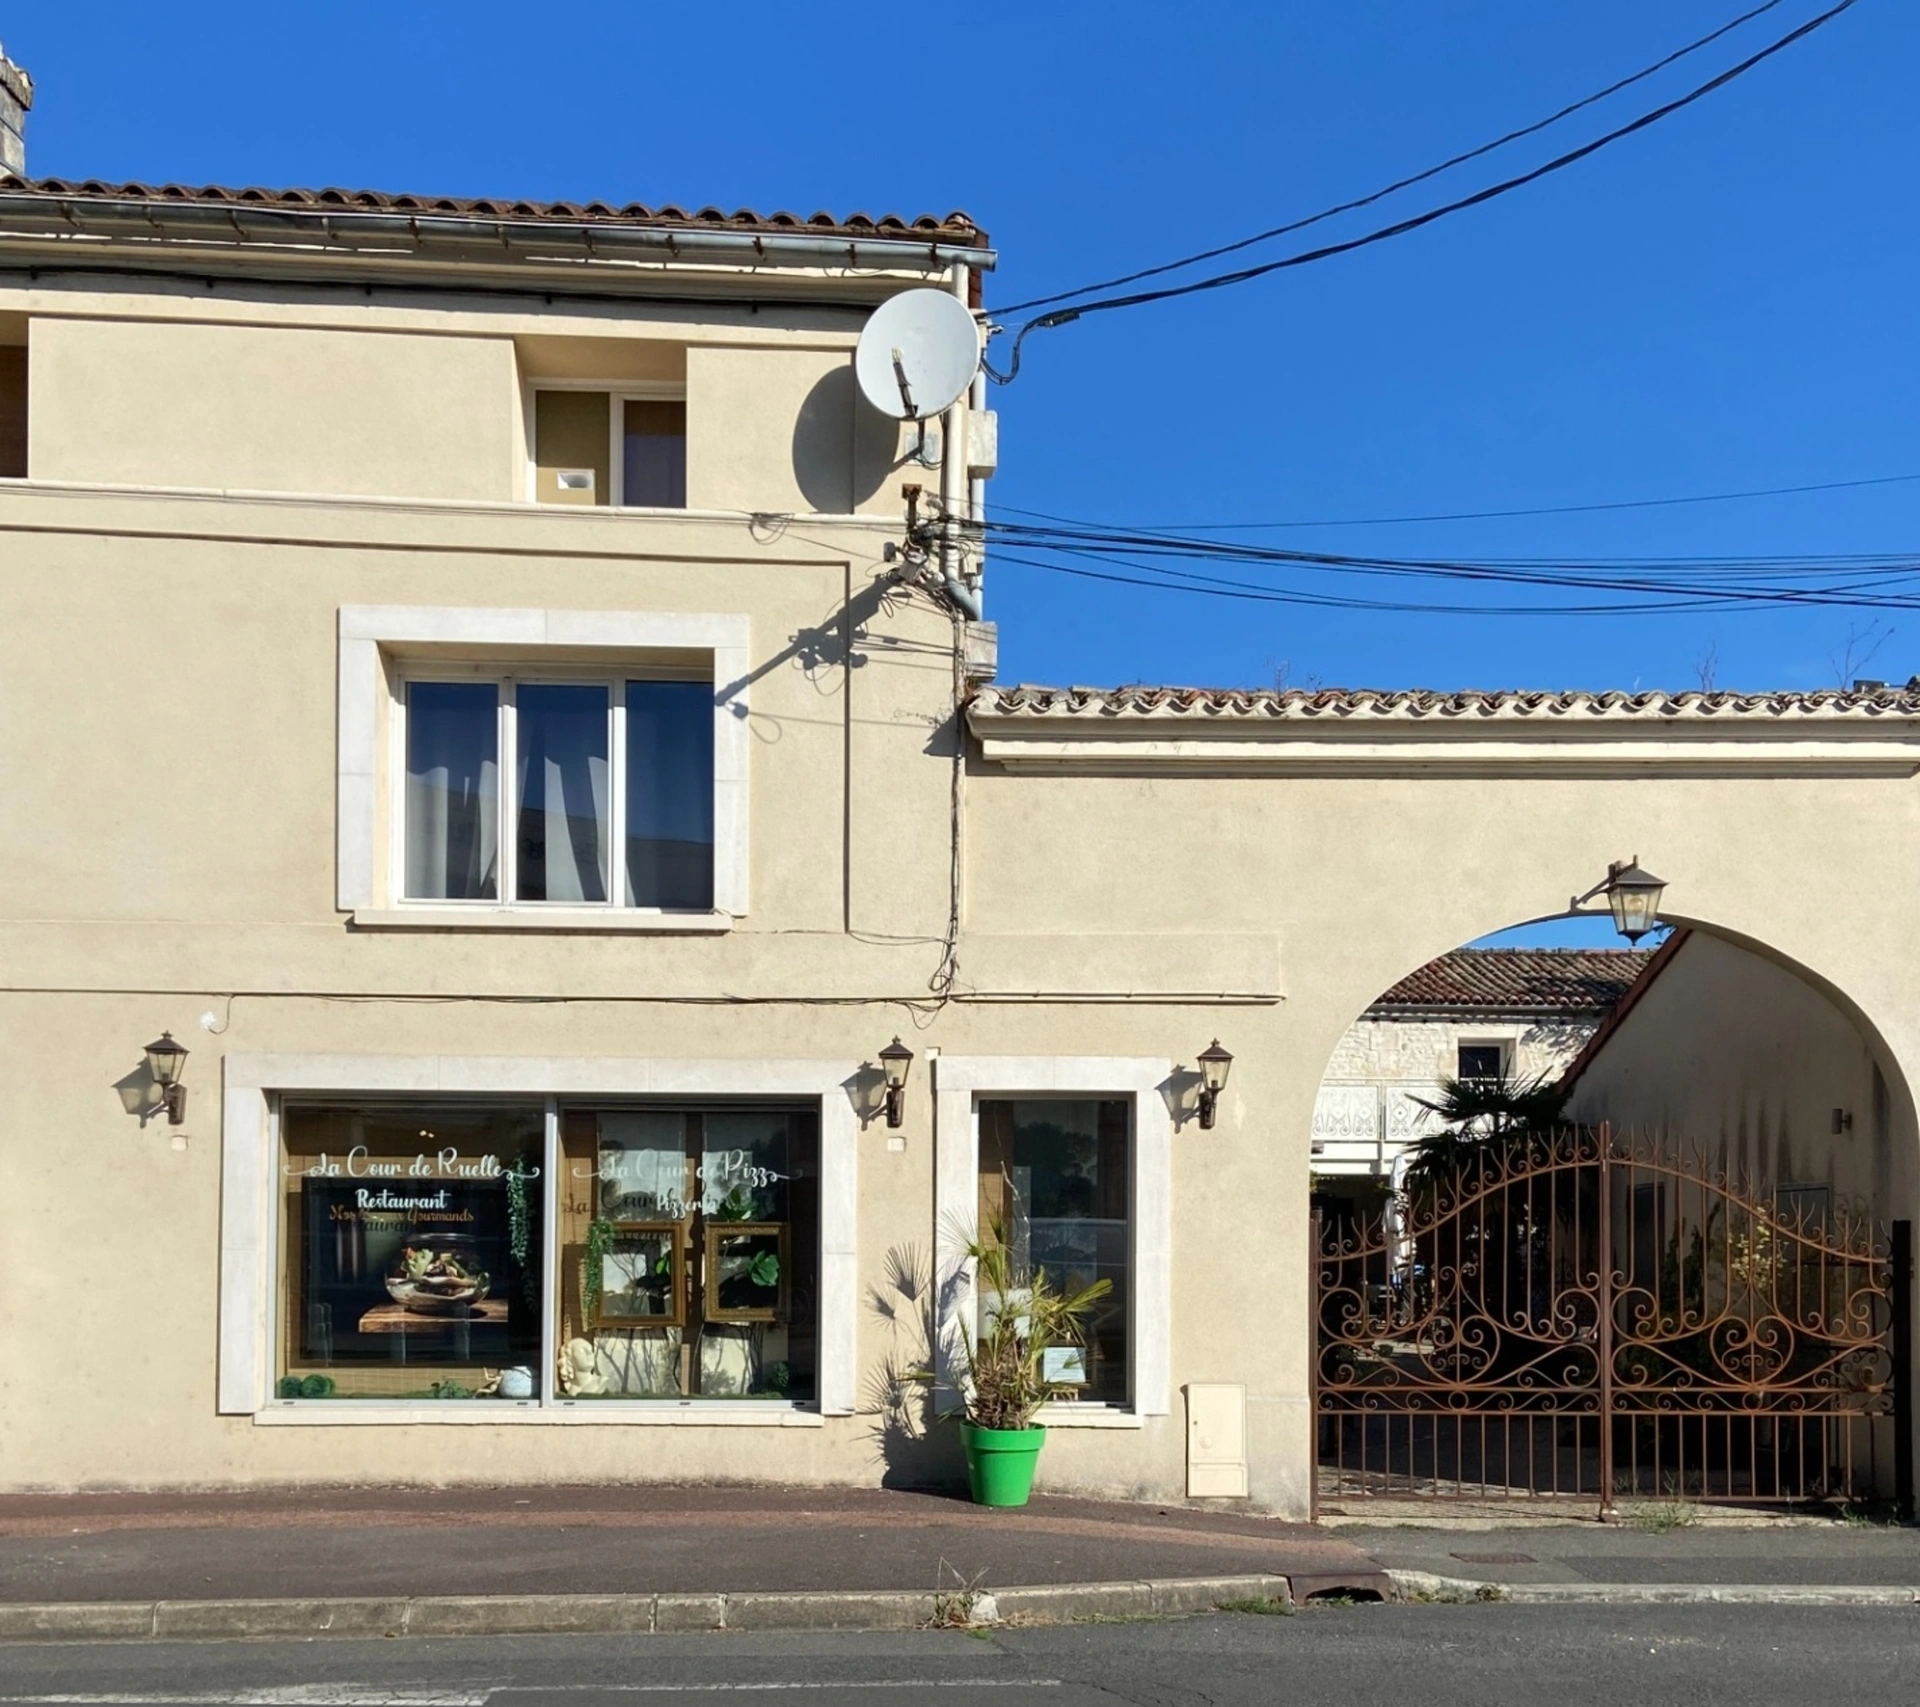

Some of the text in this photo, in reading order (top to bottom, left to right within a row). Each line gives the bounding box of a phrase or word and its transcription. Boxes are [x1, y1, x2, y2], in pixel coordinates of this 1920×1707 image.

[300, 1145, 515, 1181] La Cour de Ruelle
[355, 1187, 453, 1210] Restaurant
